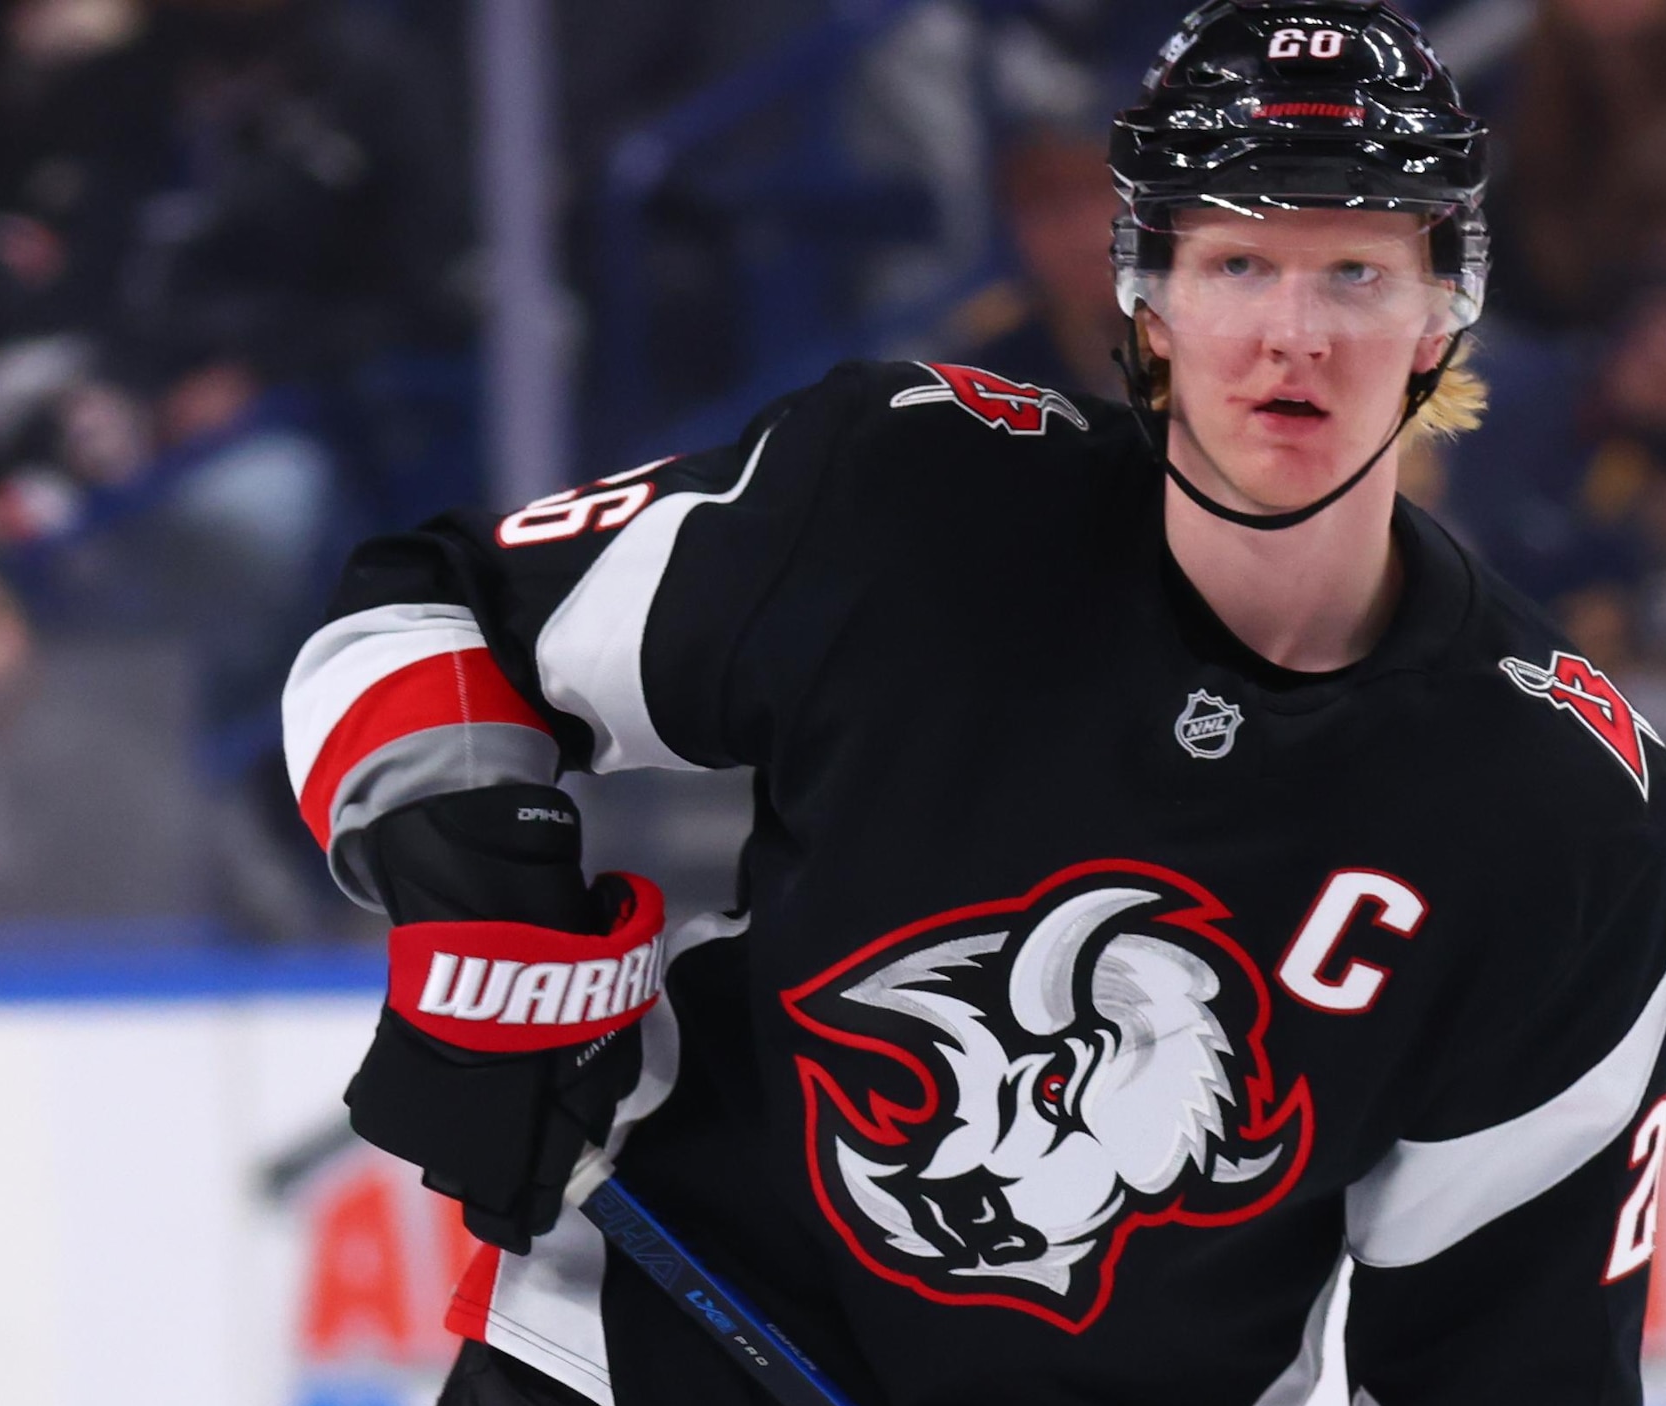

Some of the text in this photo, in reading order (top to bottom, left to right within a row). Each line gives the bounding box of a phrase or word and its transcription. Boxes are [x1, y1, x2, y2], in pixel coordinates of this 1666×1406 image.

[494, 457, 681, 548] 6
[1186, 717, 1227, 738] NHL
[418, 935, 664, 1025] WARRI
[1274, 866, 1429, 1015] C
